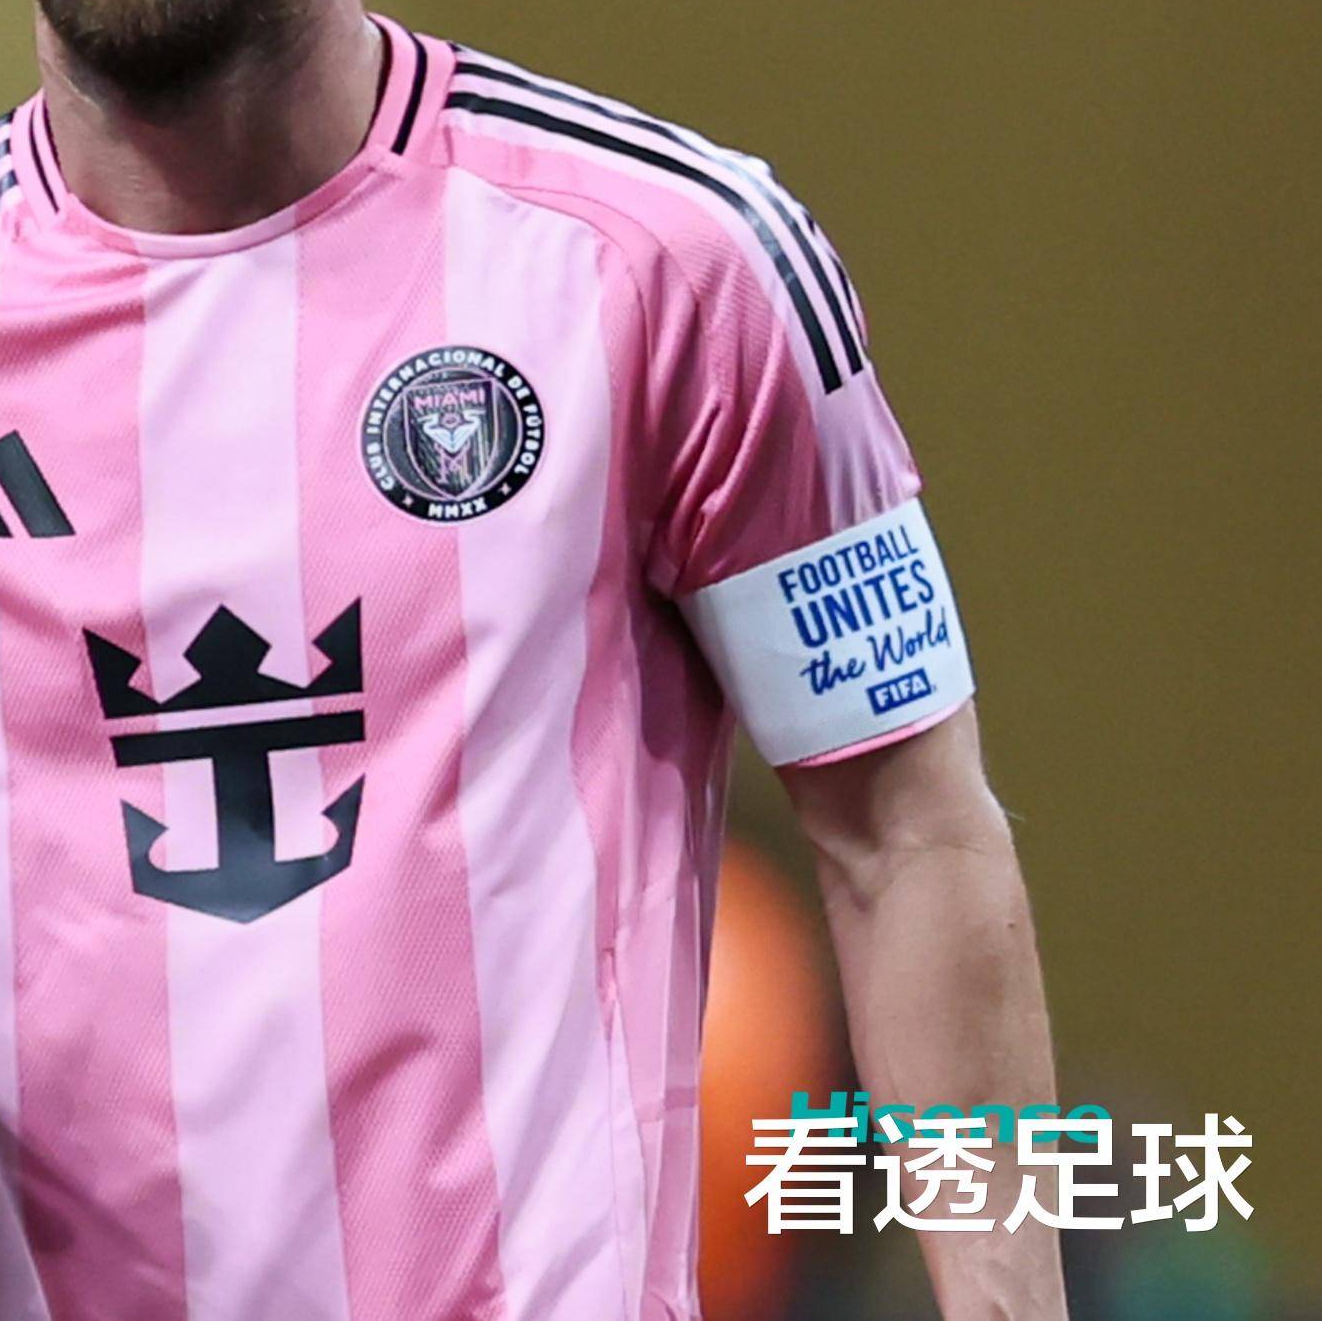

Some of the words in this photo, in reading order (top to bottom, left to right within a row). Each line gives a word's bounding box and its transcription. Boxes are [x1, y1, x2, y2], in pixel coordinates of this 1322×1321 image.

[366, 350, 505, 435] INTERNACIONAL
[413, 387, 486, 411] MIAMI
[508, 375, 531, 400] DE
[366, 442, 395, 491] CLUB
[428, 497, 488, 519] MMXX
[777, 525, 919, 603] FOOTBALL
[791, 559, 935, 649] UNITES
[799, 650, 867, 696] the
[866, 606, 952, 673] World
[872, 672, 930, 709] FIFA
